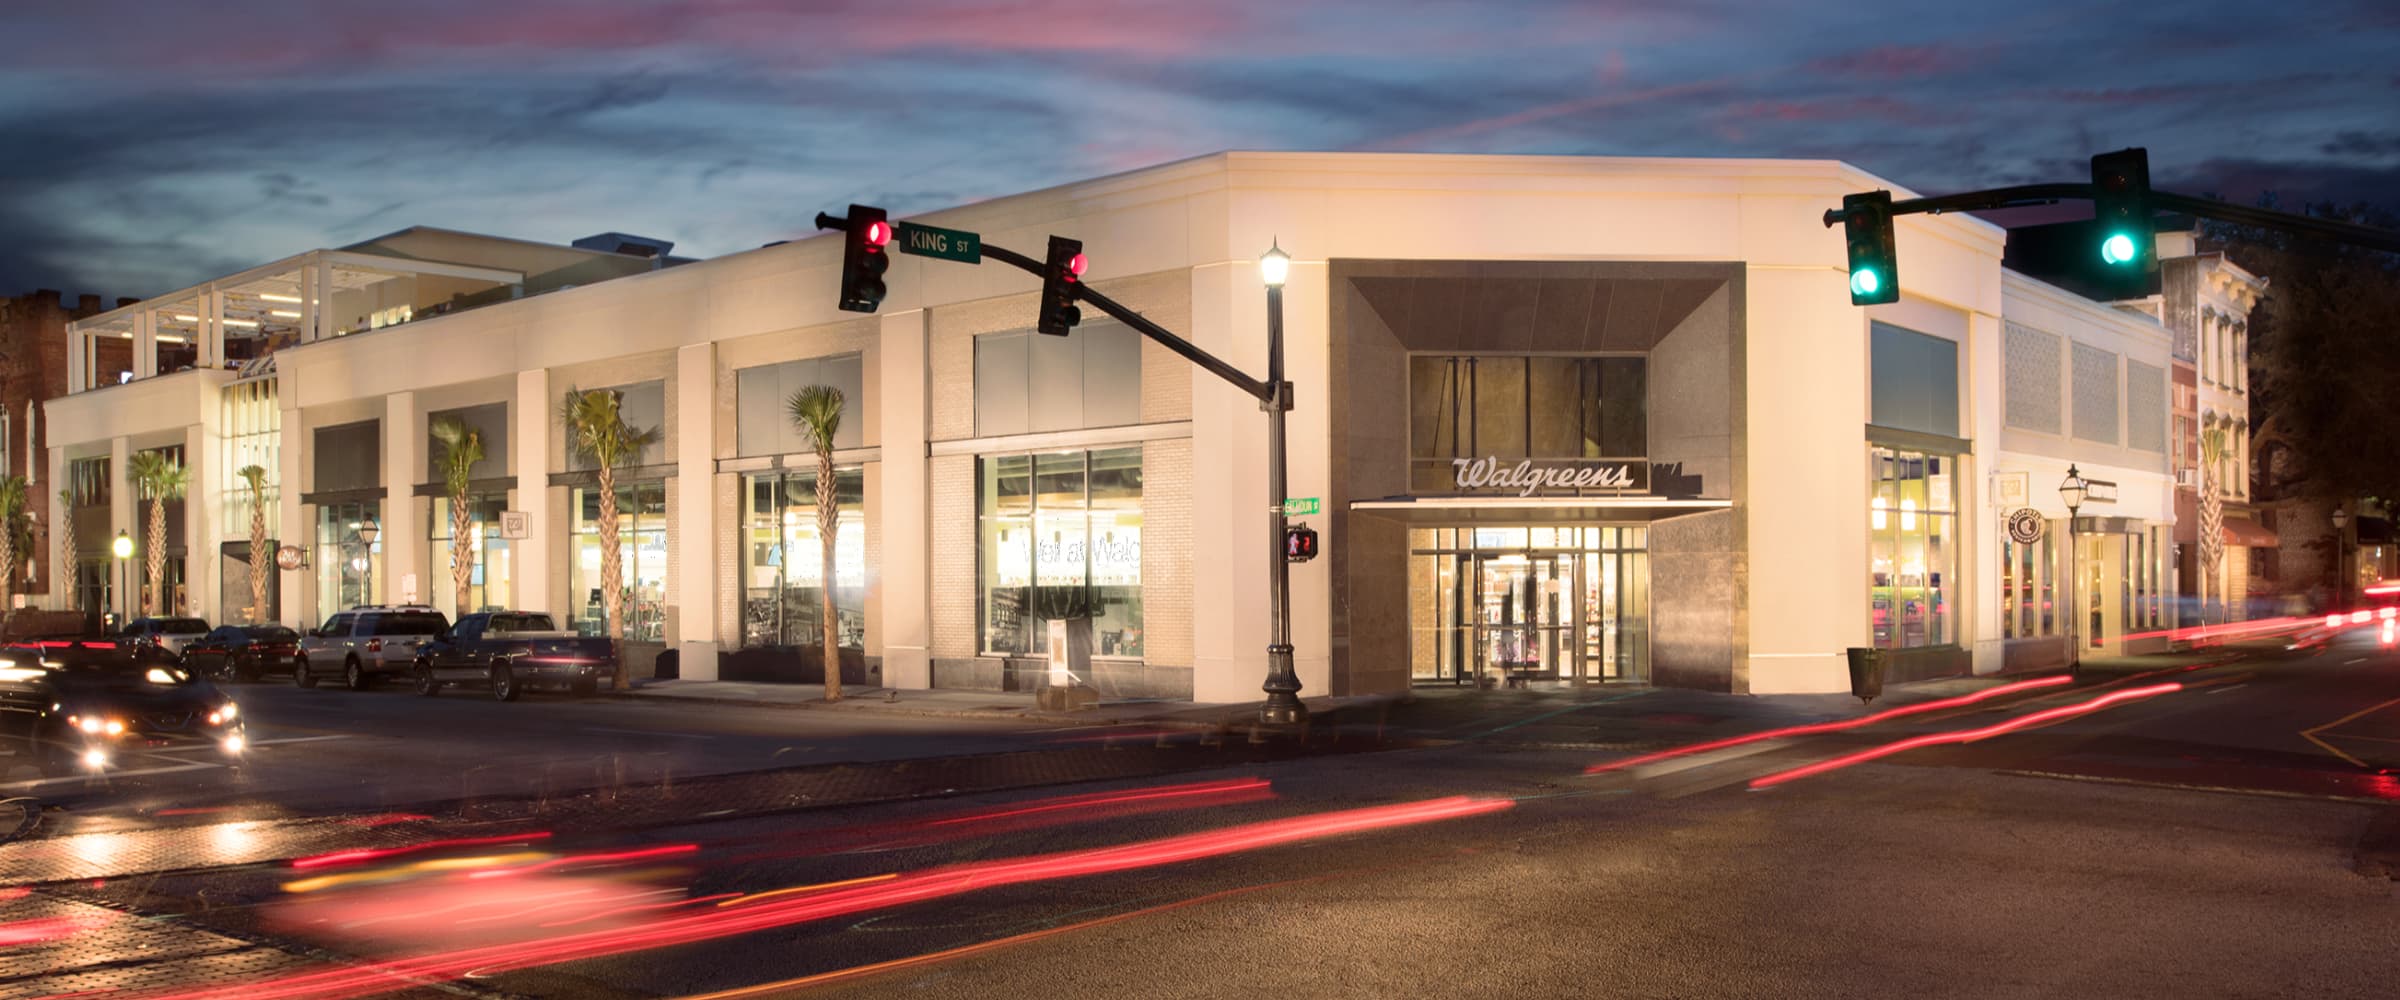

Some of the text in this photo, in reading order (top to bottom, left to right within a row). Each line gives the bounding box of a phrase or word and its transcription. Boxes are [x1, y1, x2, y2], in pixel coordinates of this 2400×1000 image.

[911, 230, 969, 253] KING ST
[1452, 456, 1634, 497] Walgreens
